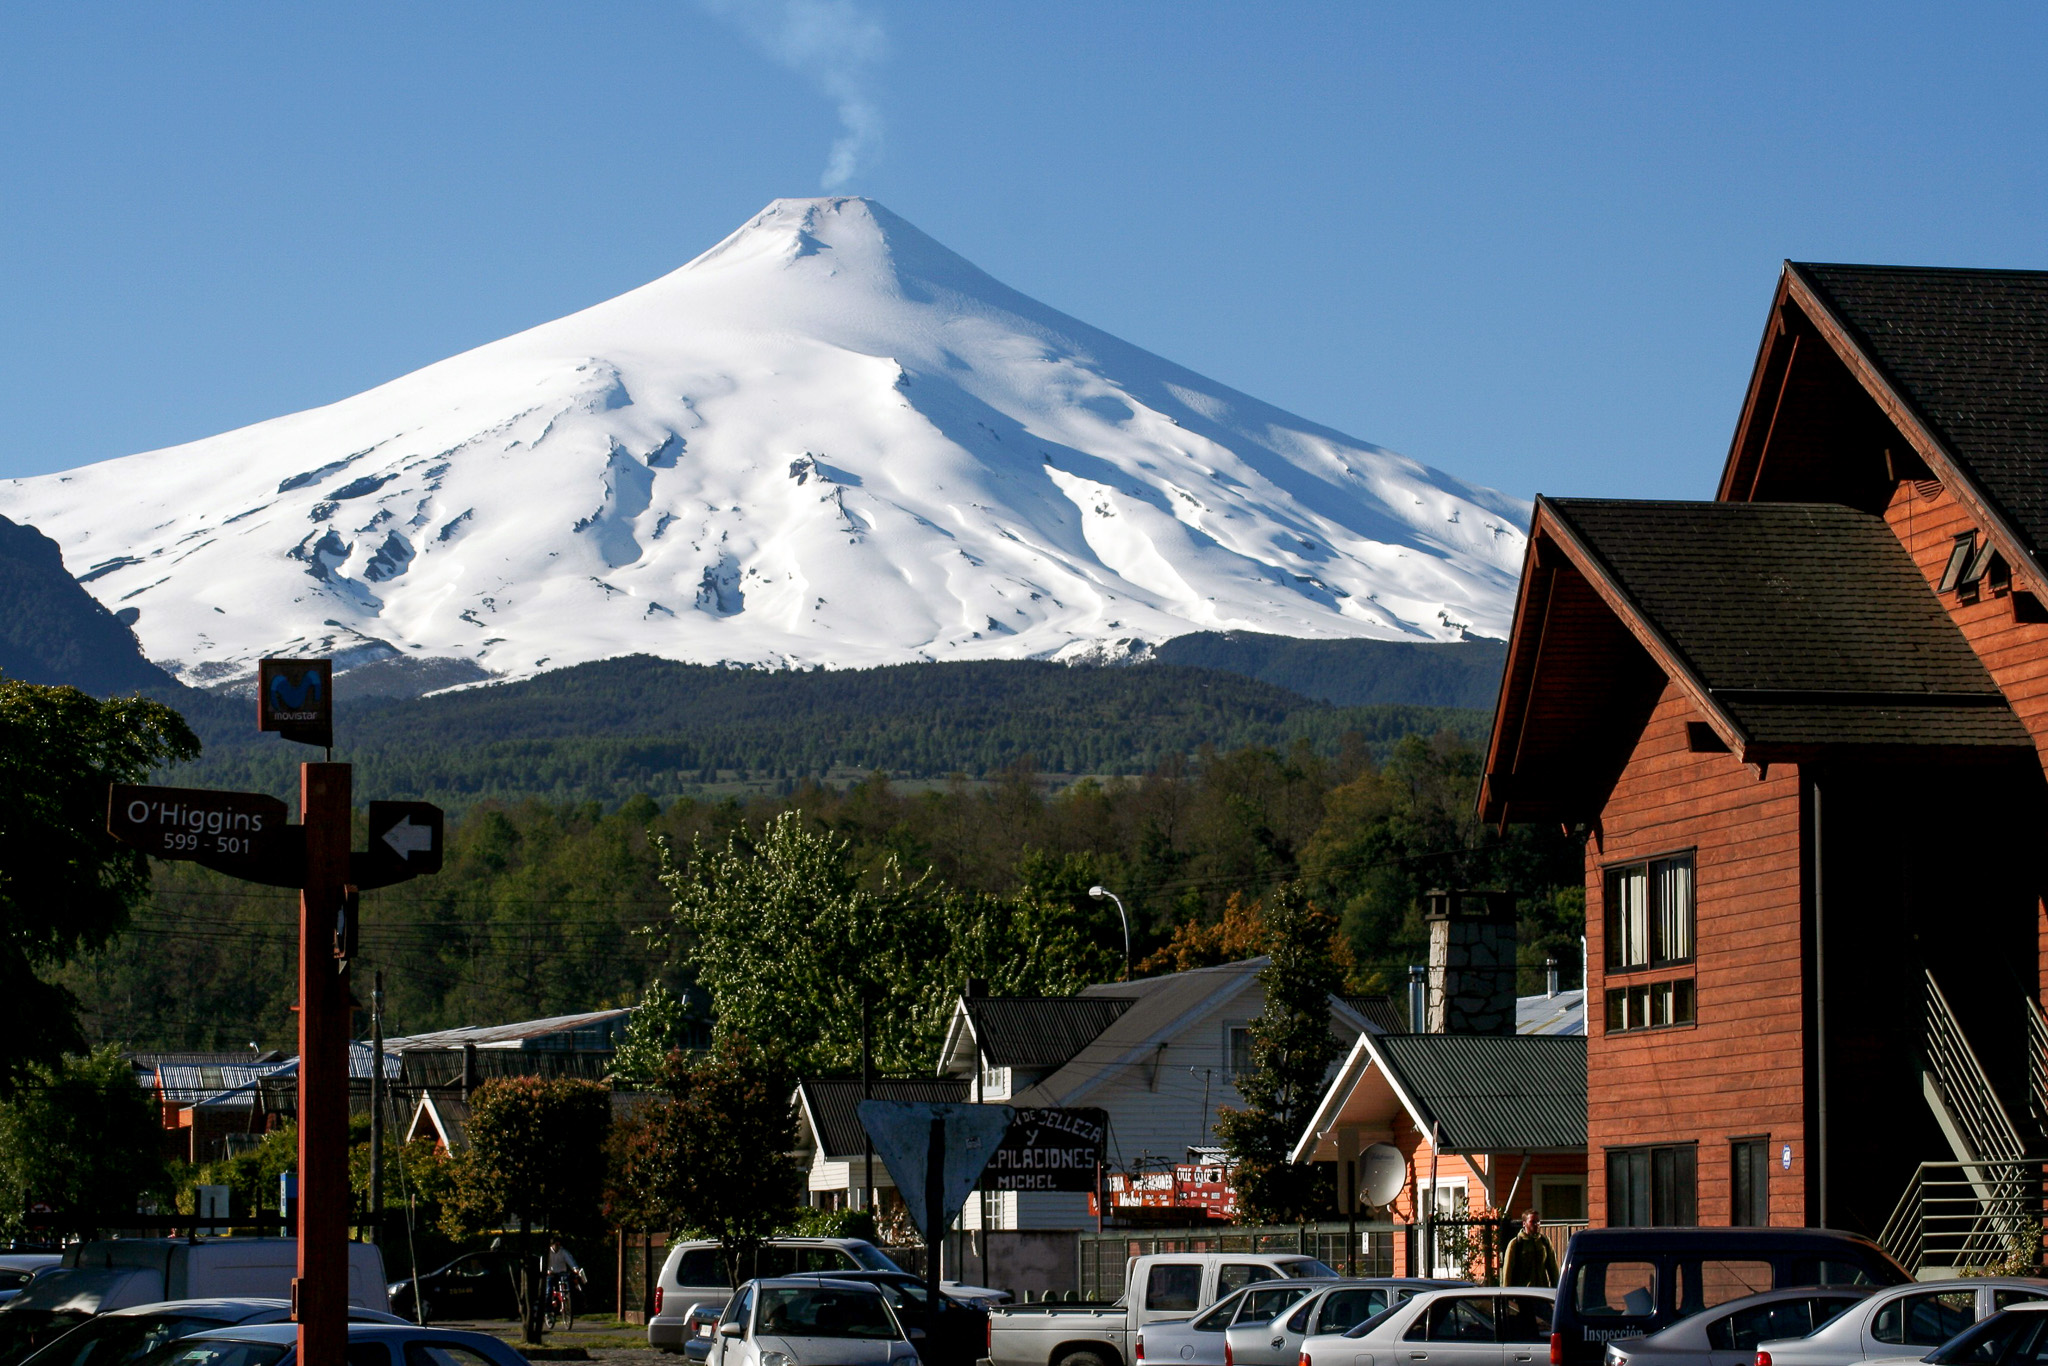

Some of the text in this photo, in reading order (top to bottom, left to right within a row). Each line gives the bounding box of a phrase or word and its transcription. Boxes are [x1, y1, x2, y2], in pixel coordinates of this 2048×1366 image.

[274, 711, 318, 720] movistar
[127, 800, 263, 835] O'Higgins
[163, 832, 198, 850] 599
[216, 836, 250, 854] 501
[1021, 1109, 1036, 1122] DE
[997, 1174, 1057, 1189] MICHEL
[1583, 1325, 1644, 1346] Inspección
